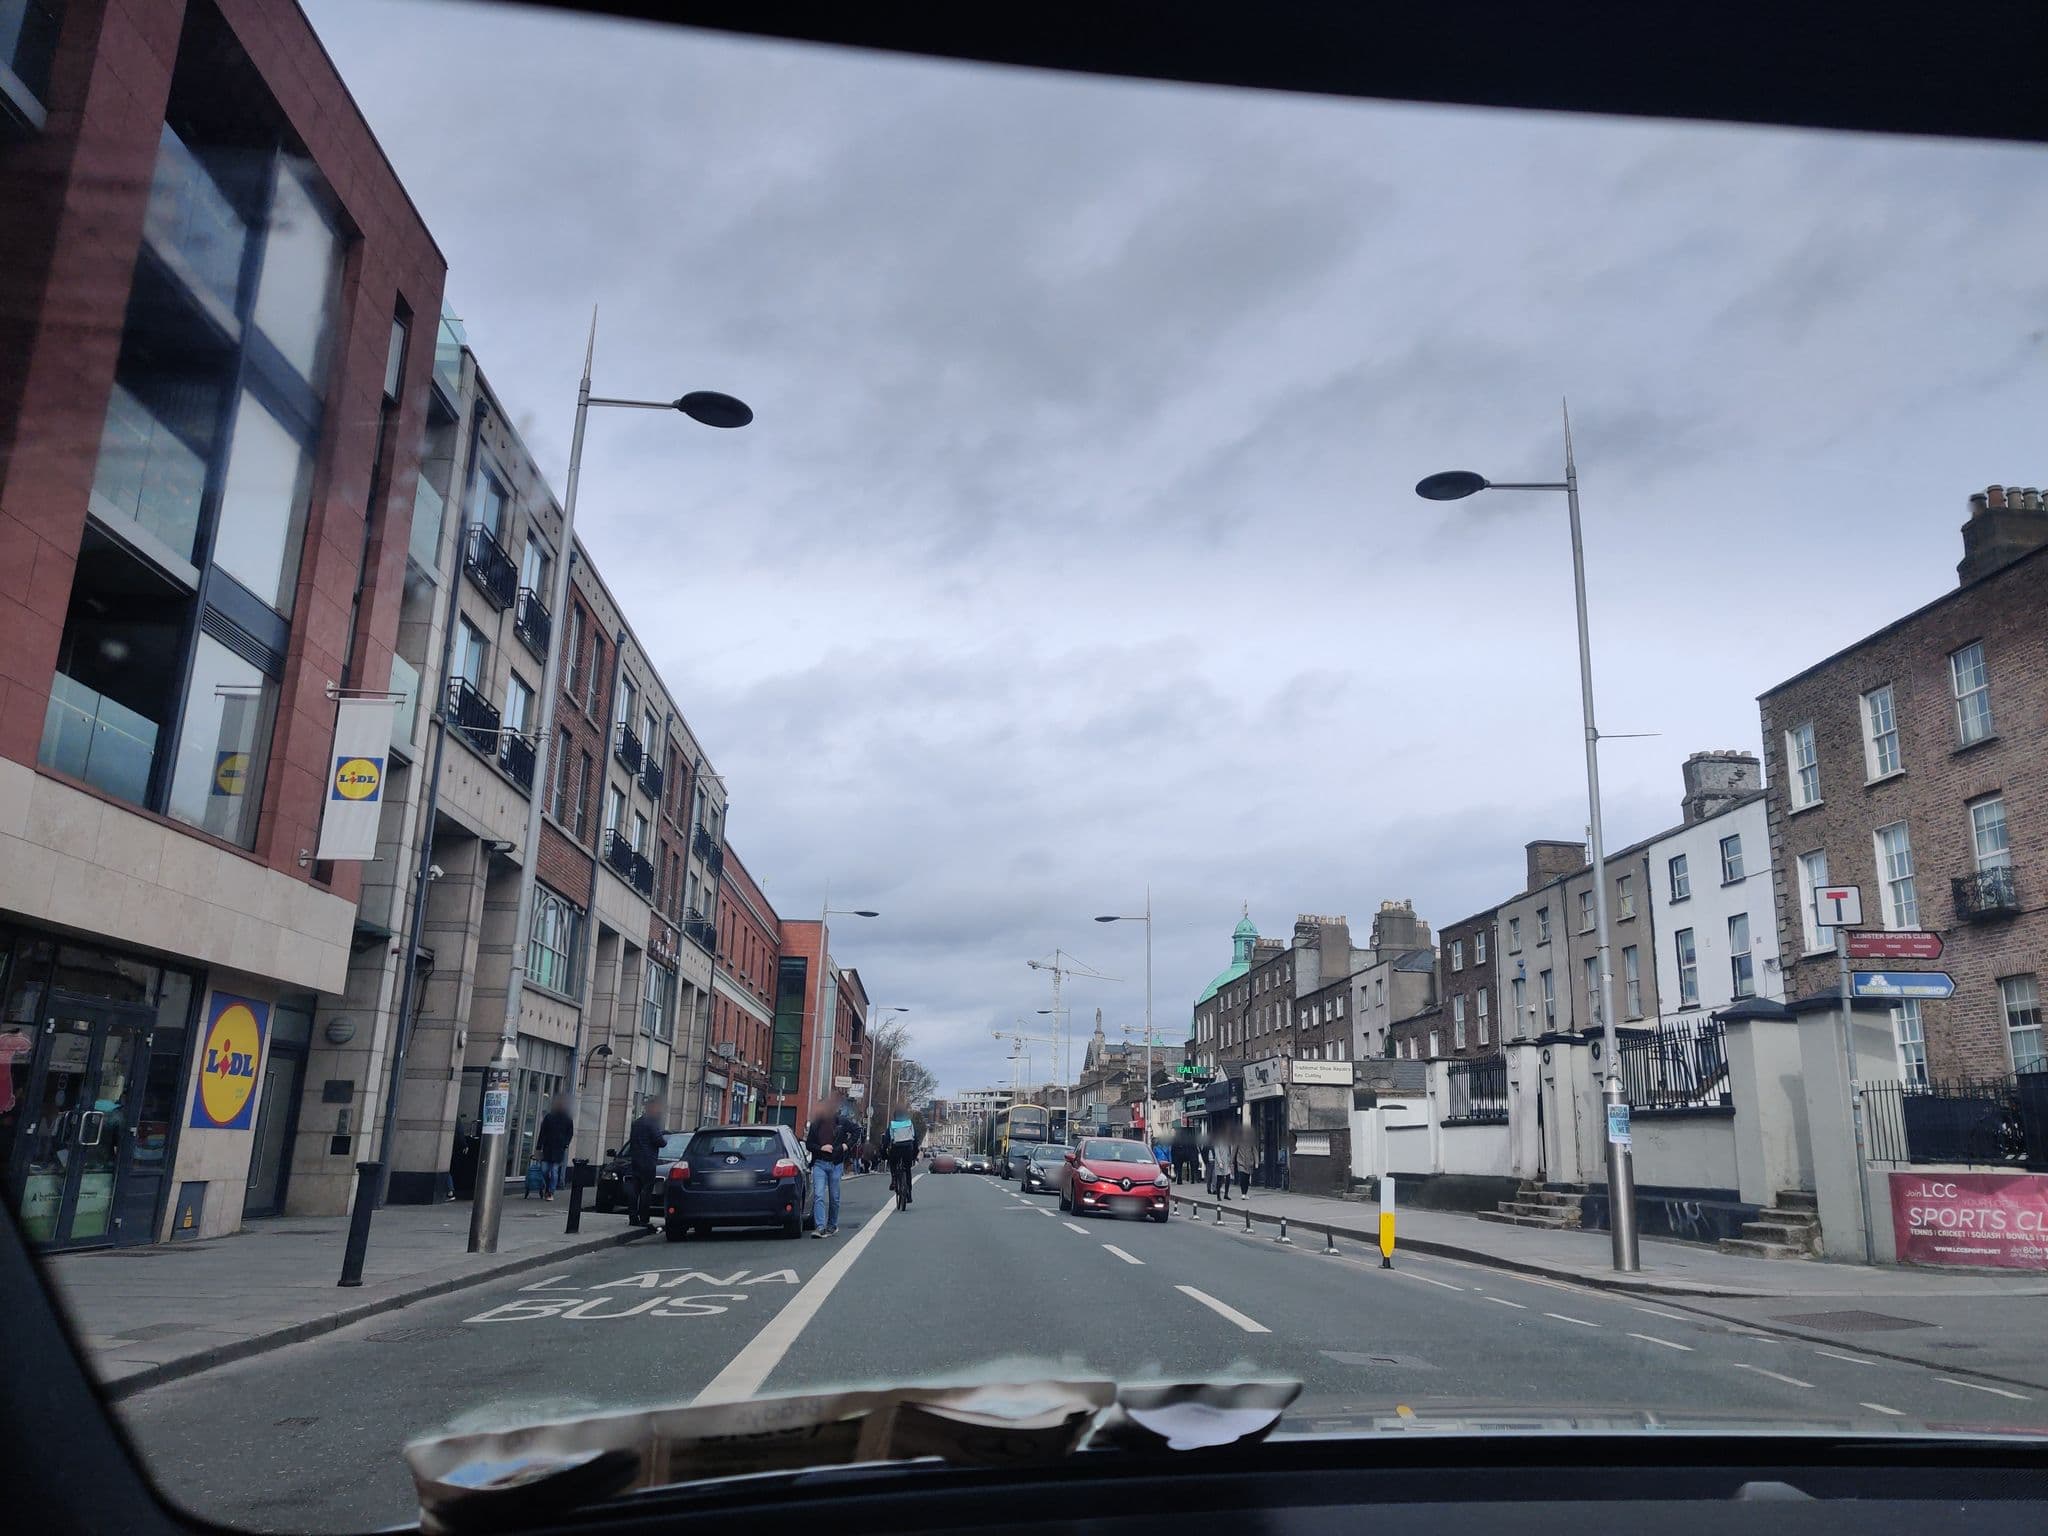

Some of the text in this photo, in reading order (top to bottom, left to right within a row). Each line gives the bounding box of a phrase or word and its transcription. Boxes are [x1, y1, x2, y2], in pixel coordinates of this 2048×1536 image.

[1922, 1183, 1958, 1198] LCC
[1909, 1207, 2007, 1230] SPORTS
[1911, 1228, 1933, 1236] TENNIS
[1937, 1230, 1966, 1238] CRICKET
[1970, 1231, 2000, 1239] SQUASH
[2005, 1232, 2035, 1241] BOWLS
[462, 1294, 749, 1322] BUS
